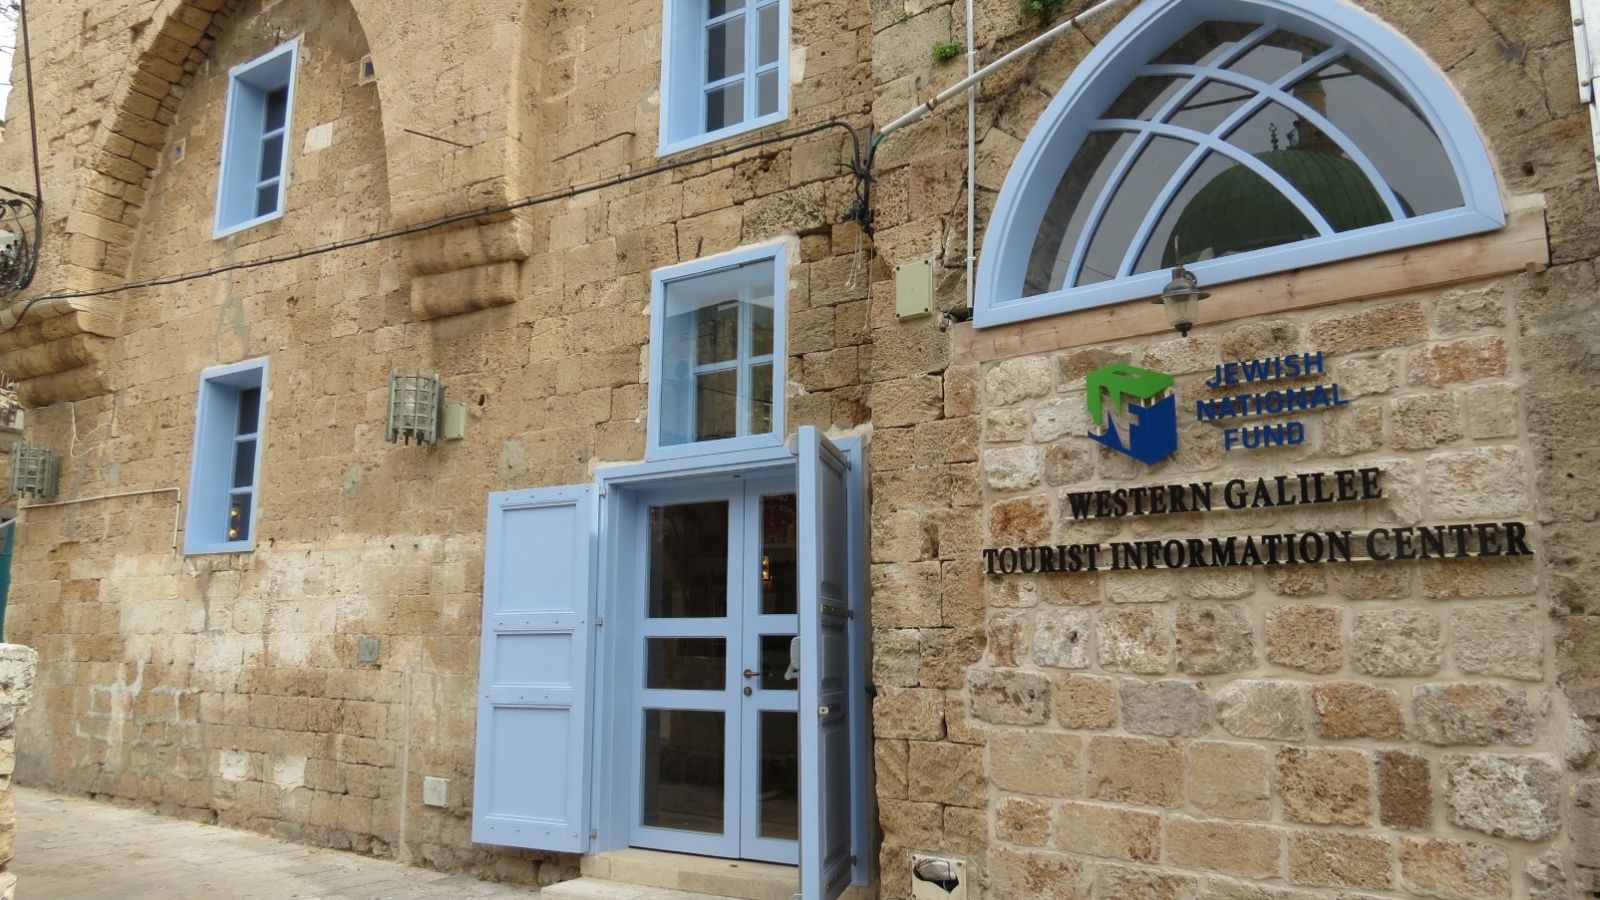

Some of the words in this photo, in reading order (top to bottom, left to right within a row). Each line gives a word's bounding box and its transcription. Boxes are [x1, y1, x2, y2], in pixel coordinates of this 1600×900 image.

[1206, 351, 1324, 388] JEWISH
[1196, 383, 1350, 422] NATIONAL
[1224, 421, 1305, 451] FUND
[1067, 482, 1212, 520] WESTERN
[1224, 467, 1383, 510] GALILEE
[983, 543, 1100, 575] TOURIST
[1109, 530, 1352, 570] INFORMATION
[1366, 521, 1534, 561] CENTER
